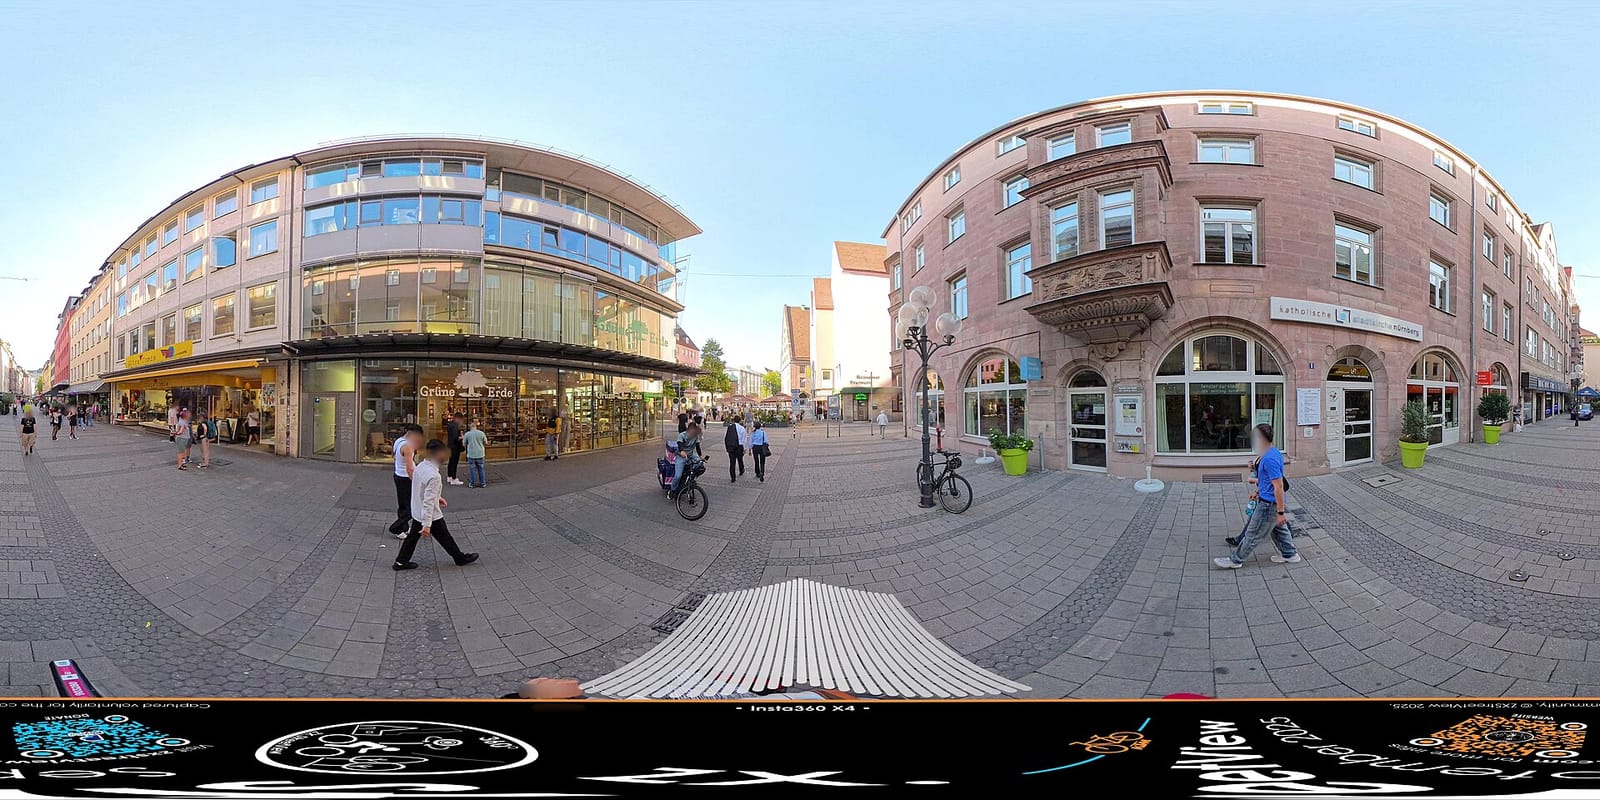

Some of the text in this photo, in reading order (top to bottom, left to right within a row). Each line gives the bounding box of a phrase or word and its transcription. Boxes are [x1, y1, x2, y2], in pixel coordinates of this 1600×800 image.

[1279, 305, 1331, 319] katholische
[1393, 324, 1421, 337] nürnberg
[420, 386, 513, 398] Grüne Erde
